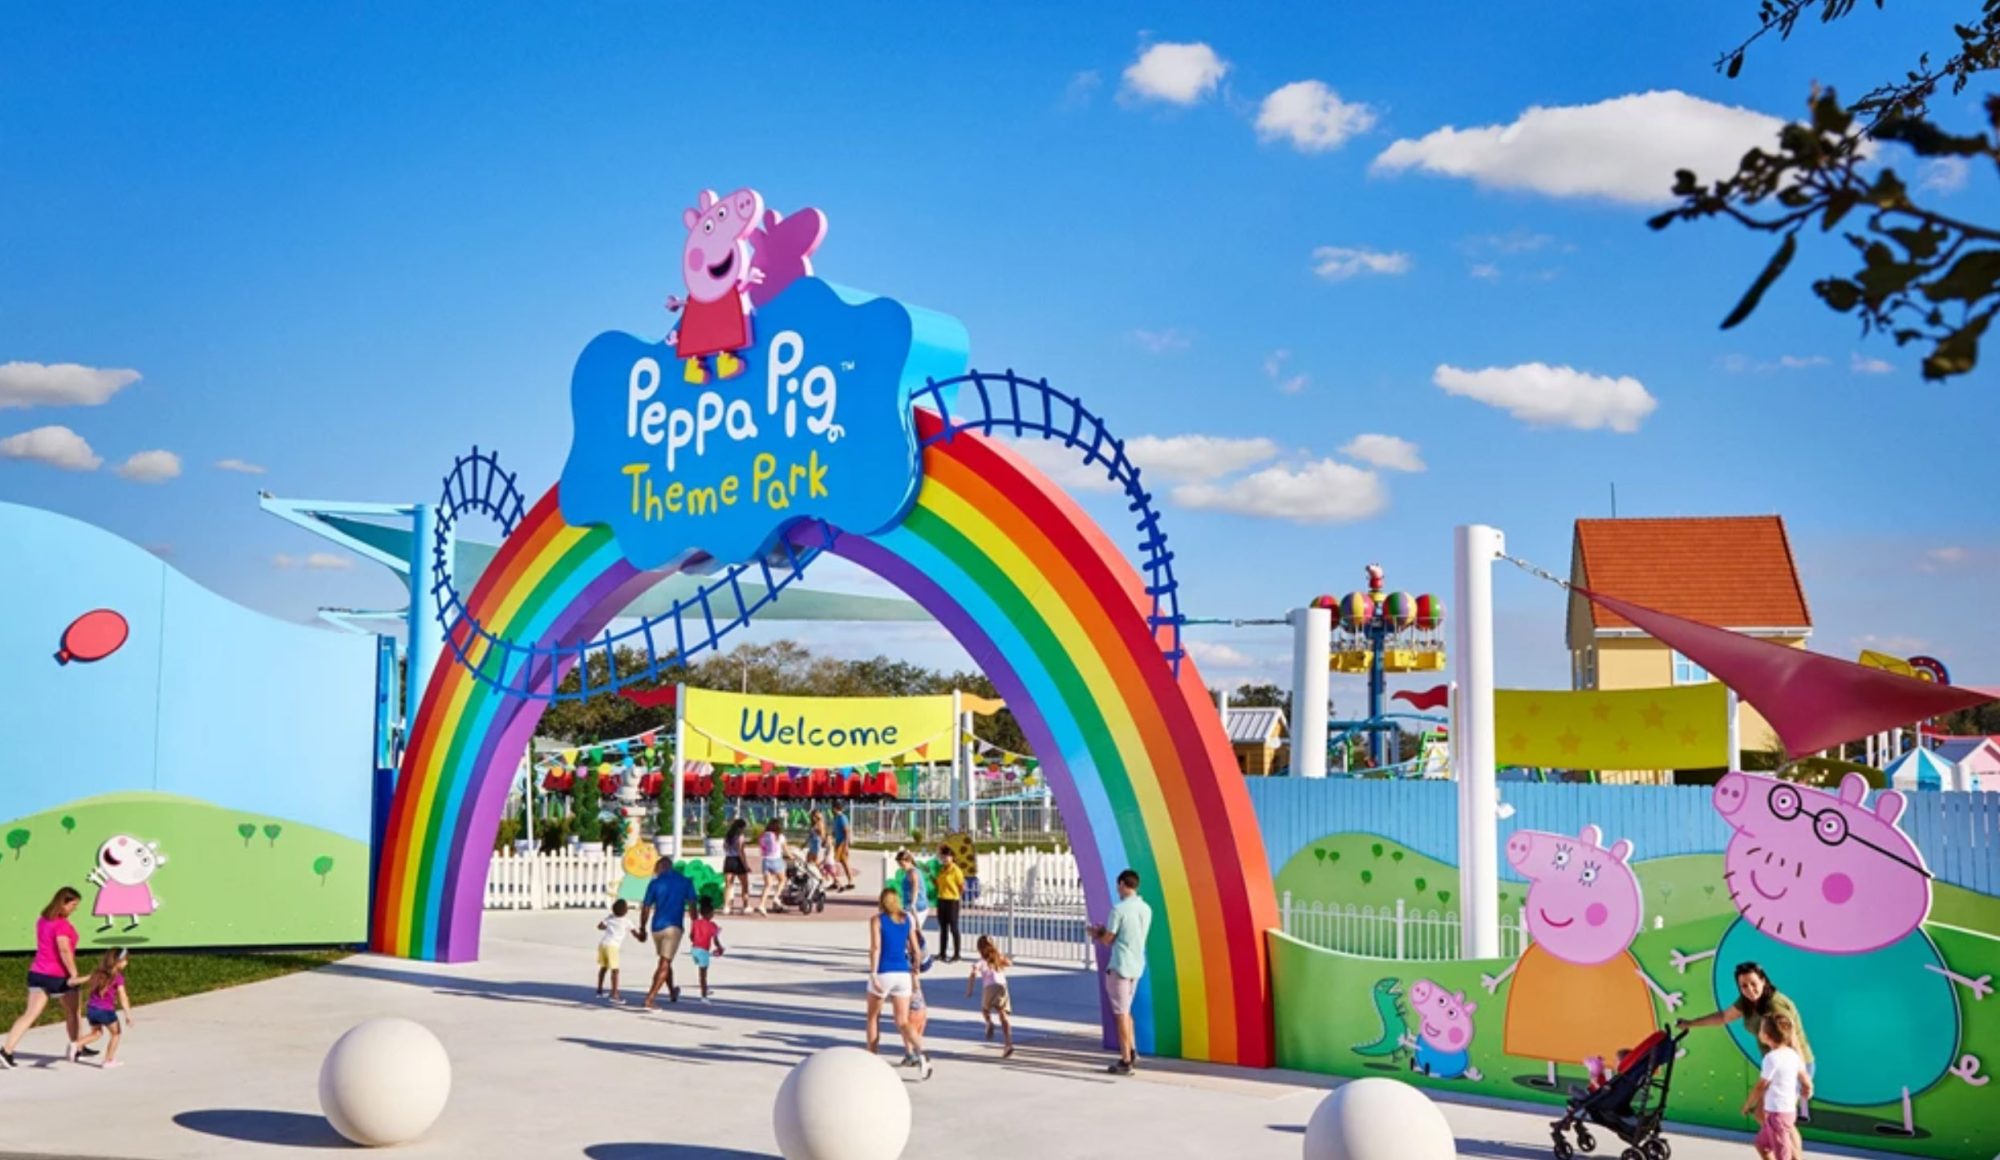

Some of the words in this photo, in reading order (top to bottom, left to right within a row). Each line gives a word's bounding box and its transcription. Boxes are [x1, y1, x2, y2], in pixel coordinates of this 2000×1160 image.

[627, 357, 758, 472] Peppa
[767, 330, 845, 443] Pig
[622, 463, 739, 522] Theme
[752, 449, 829, 510] Park
[740, 707, 898, 747] Welcome
